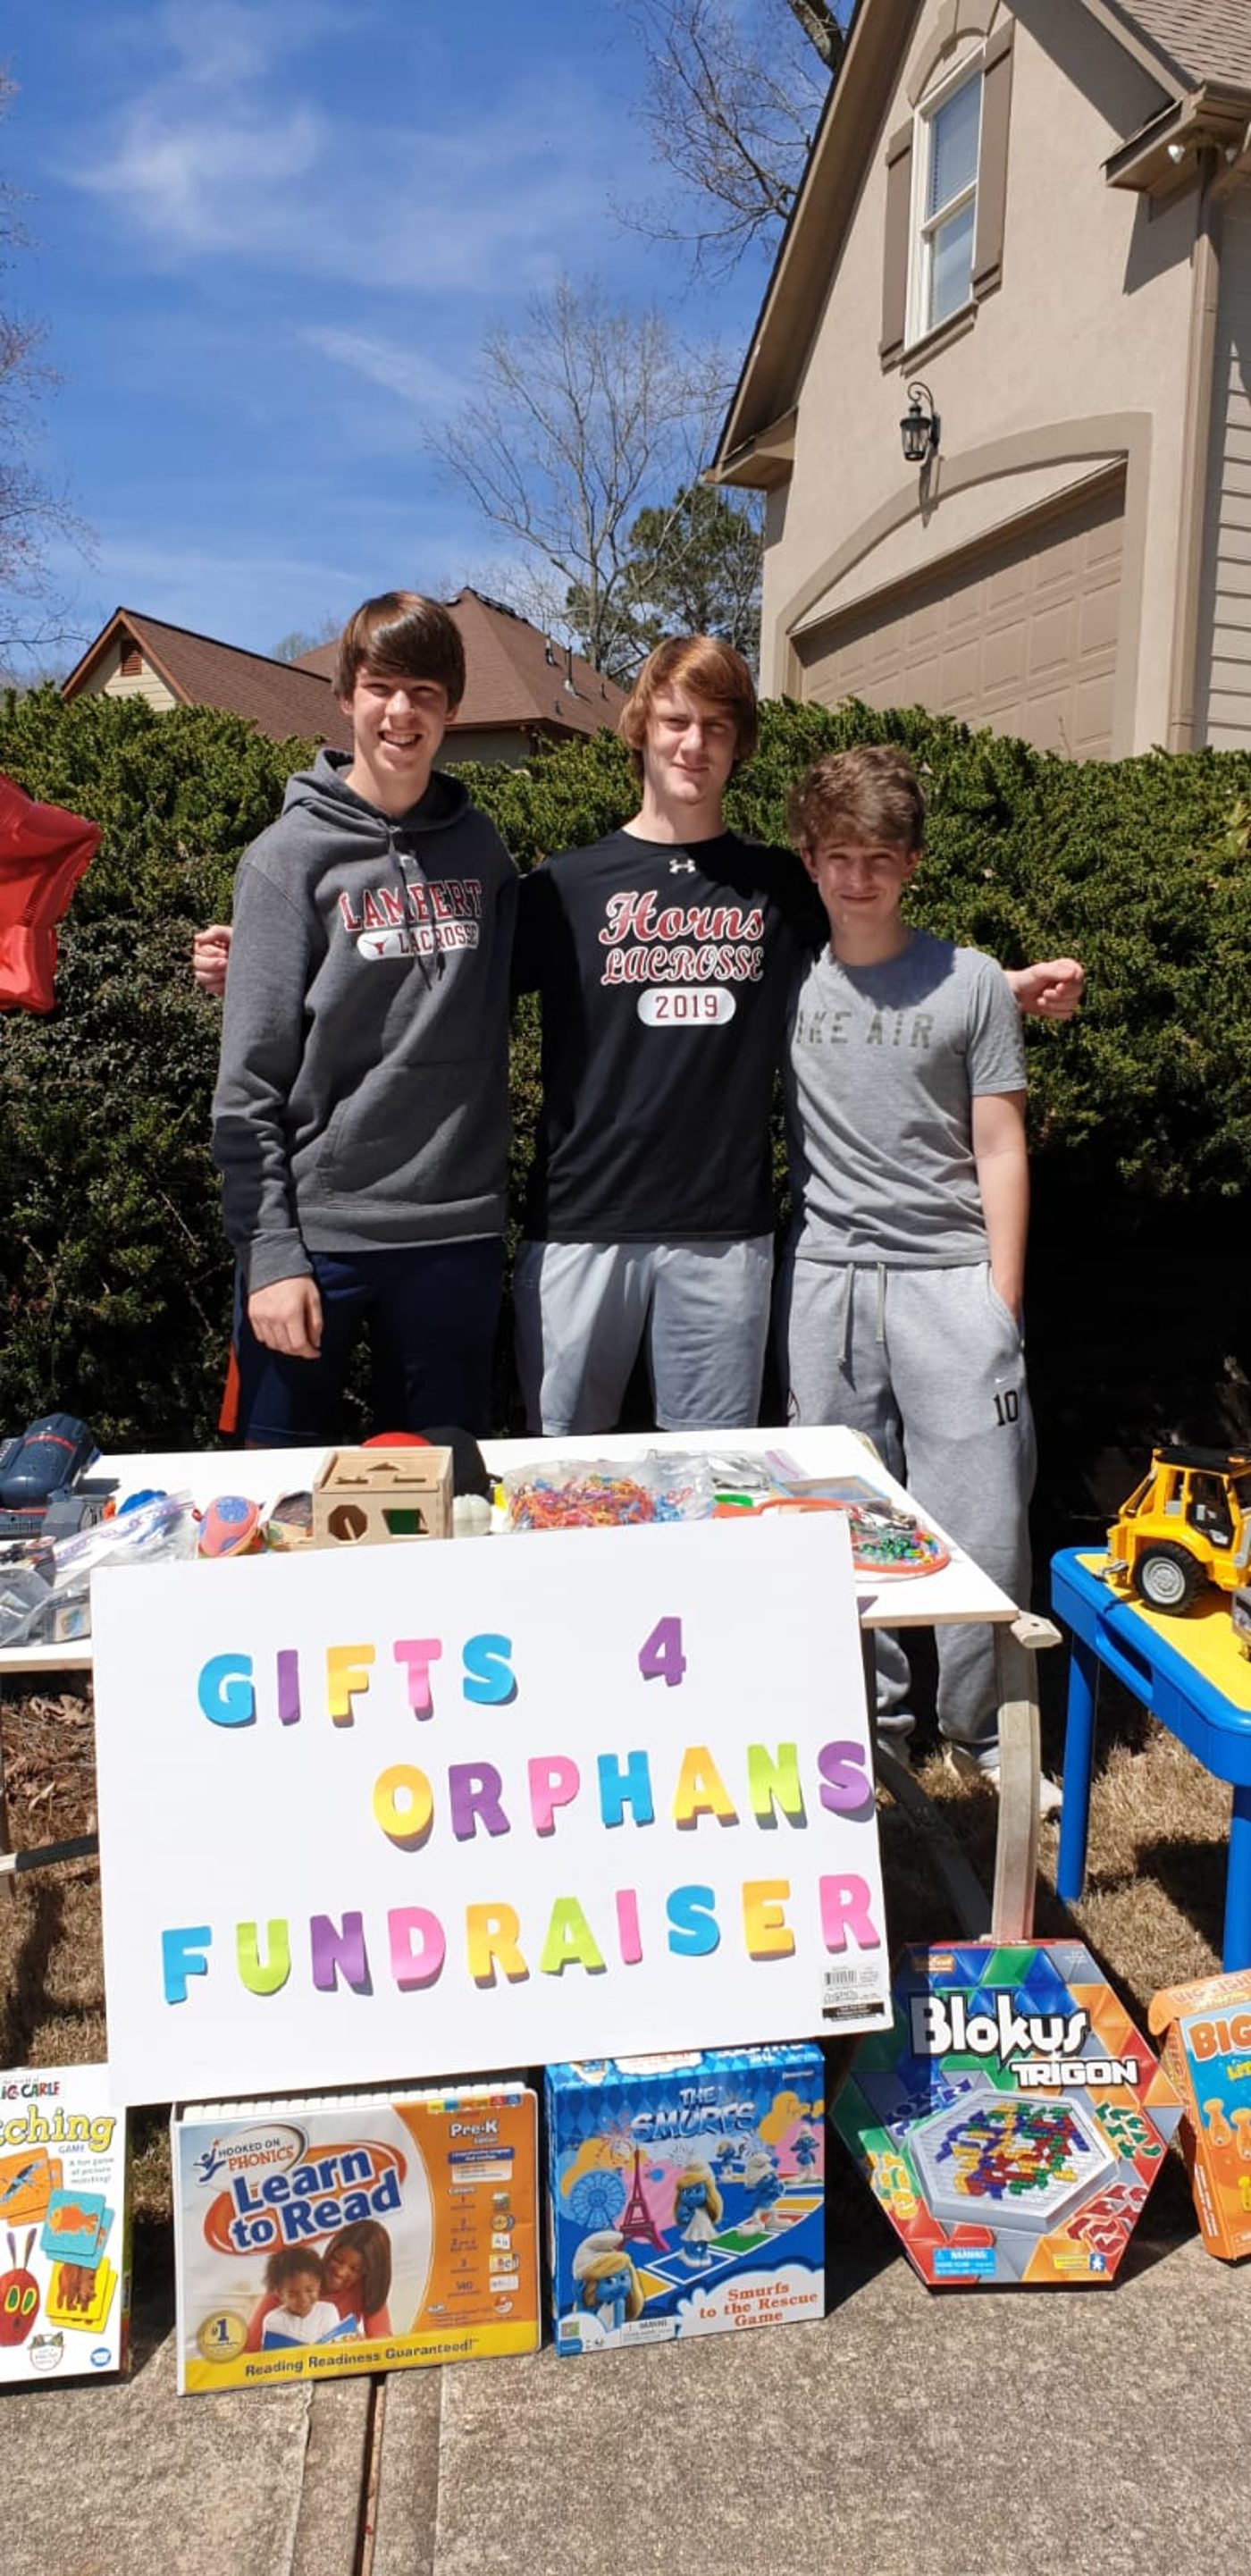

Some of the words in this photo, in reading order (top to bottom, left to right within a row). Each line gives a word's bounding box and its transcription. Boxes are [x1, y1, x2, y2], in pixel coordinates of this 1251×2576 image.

[339, 879, 483, 931] LAMBERT
[599, 890, 765, 945] Horns
[397, 923, 478, 955] LACROSSE
[600, 945, 764, 986] LACROSSE
[655, 994, 718, 1019] 2019
[795, 1010, 852, 1044] IKE
[866, 1011, 935, 1048] AIR
[993, 1389, 1019, 1427] 10
[197, 1632, 516, 1726] GIFTS
[638, 1616, 686, 1687] 4
[372, 1739, 872, 1841] ORPHANS
[162, 1873, 881, 2004] FUNDRAISER
[910, 1993, 1089, 2063] Blokus
[1188, 2012, 1251, 2061] BIG
[21, 2081, 60, 2099] CARLE
[1012, 2059, 1139, 2087] TRIGON
[680, 2086, 716, 2108] THE
[450, 2119, 498, 2137] Pre-K
[631, 2102, 756, 2142] SMURFS
[58, 2143, 85, 2154] GAME
[218, 2142, 263, 2159] HOOKED
[264, 2138, 281, 2150] ON
[229, 2146, 294, 2172] PHONICS
[233, 2150, 373, 2214] Learn
[231, 2217, 274, 2249] to
[281, 2168, 402, 2242] Read
[700, 2308, 718, 2319] to
[724, 2302, 751, 2316] the
[759, 2294, 819, 2311] Rescue
[728, 2281, 790, 2302] Smurfs
[735, 2312, 784, 2328] Game
[246, 2360, 303, 2377] Reading
[308, 2352, 381, 2369] Readiness
[385, 2338, 474, 2359] Guaranteed!
